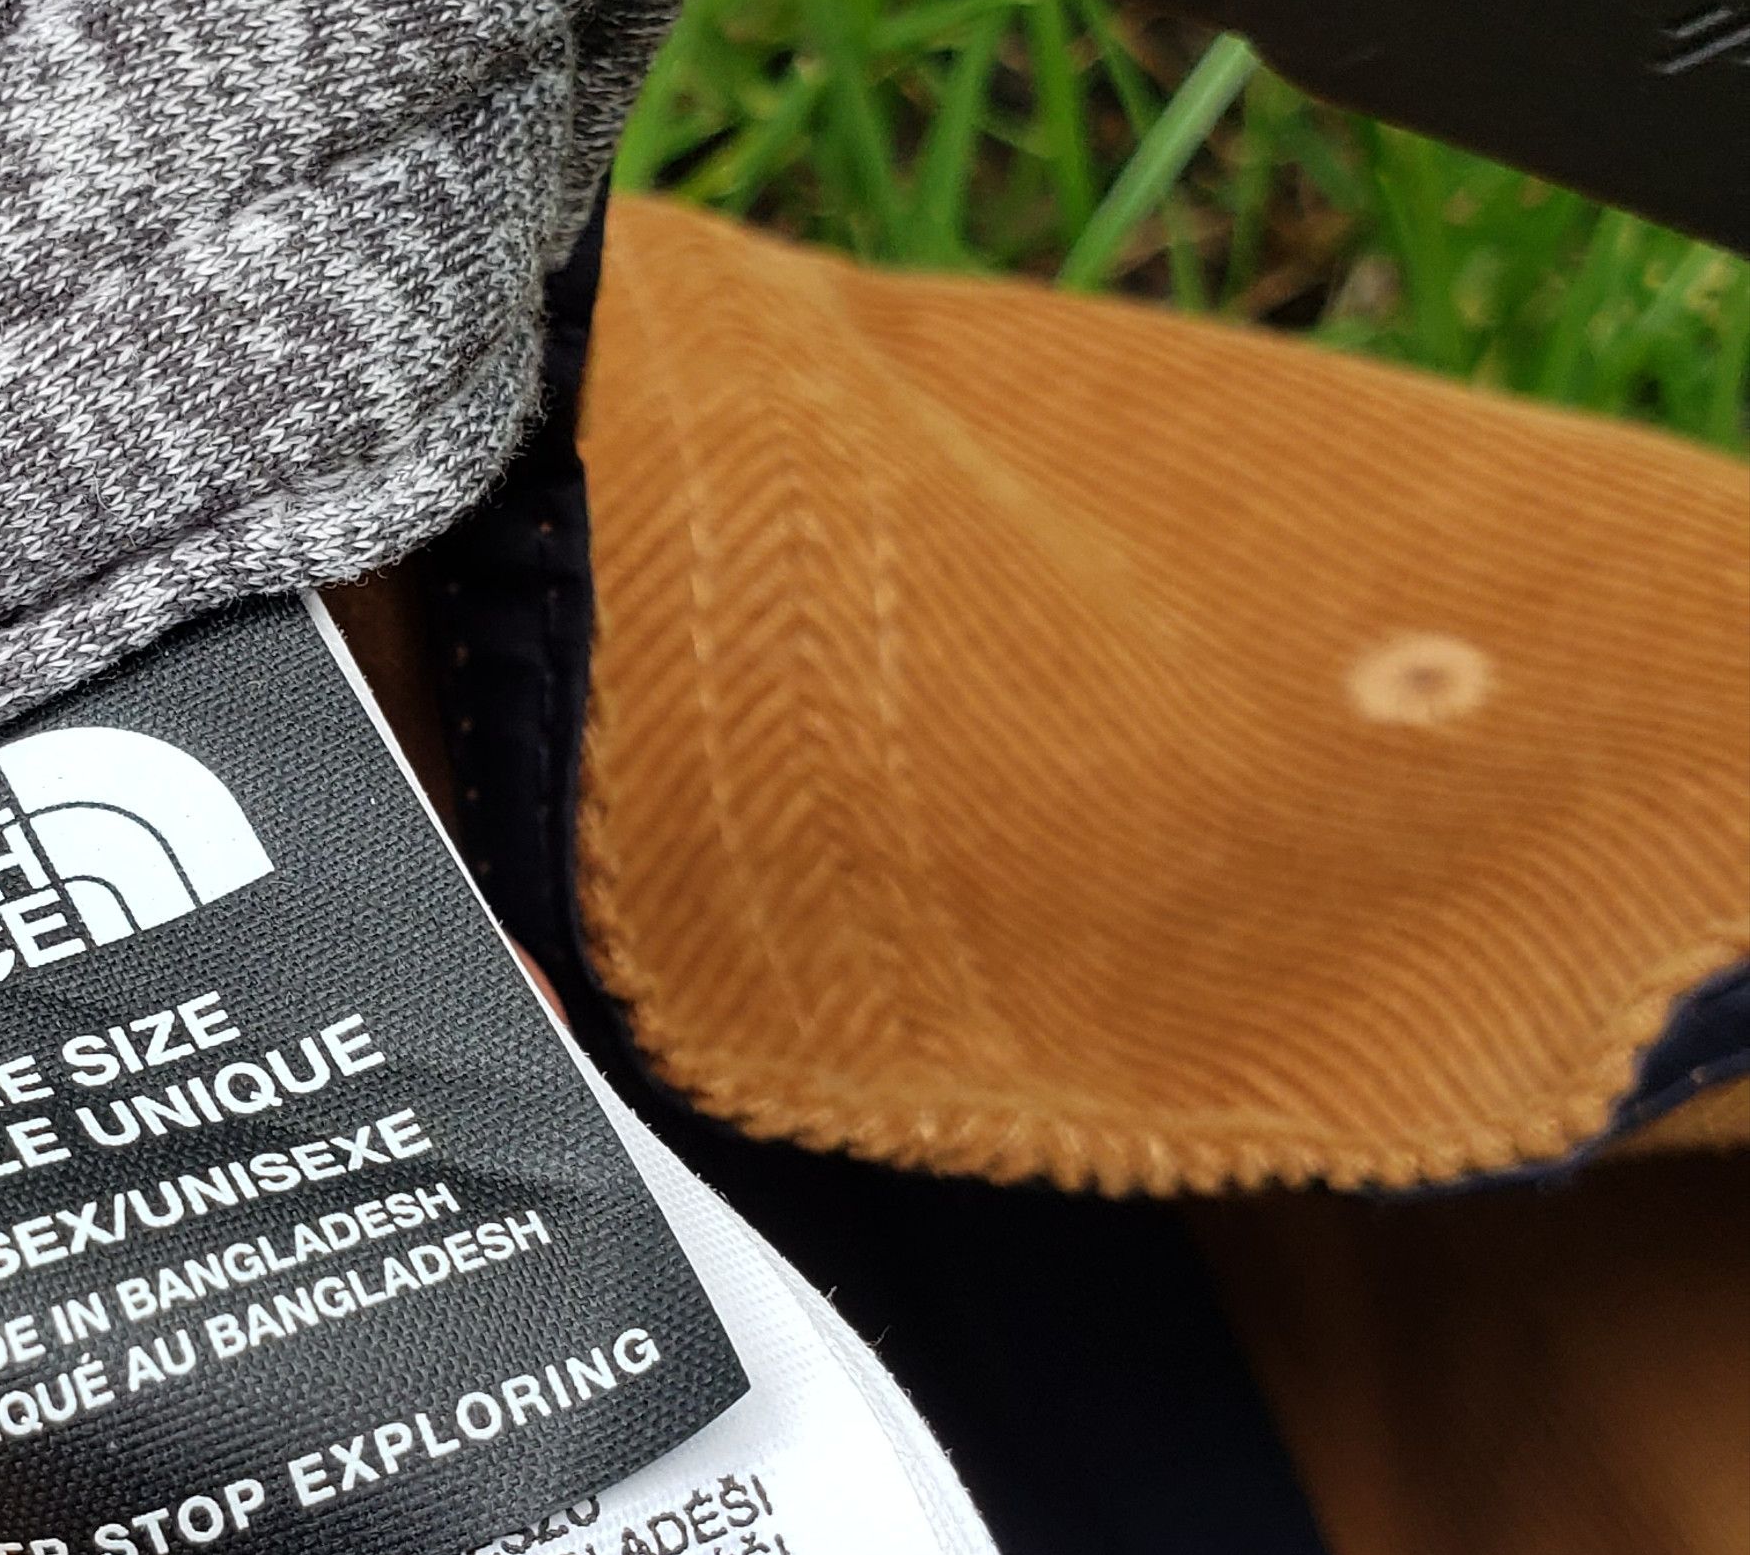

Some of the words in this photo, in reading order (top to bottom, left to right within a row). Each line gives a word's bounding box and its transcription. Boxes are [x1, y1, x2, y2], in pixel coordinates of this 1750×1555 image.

[62, 991, 241, 1086] SIZE
[75, 1013, 386, 1146] UNIQUE
[52, 1295, 113, 1347] IN
[117, 1181, 461, 1324] BANGLADESH
[126, 1330, 197, 1386] AU
[207, 1209, 553, 1361] BANGLADESH
[287, 1327, 661, 1510] EXPLORING
